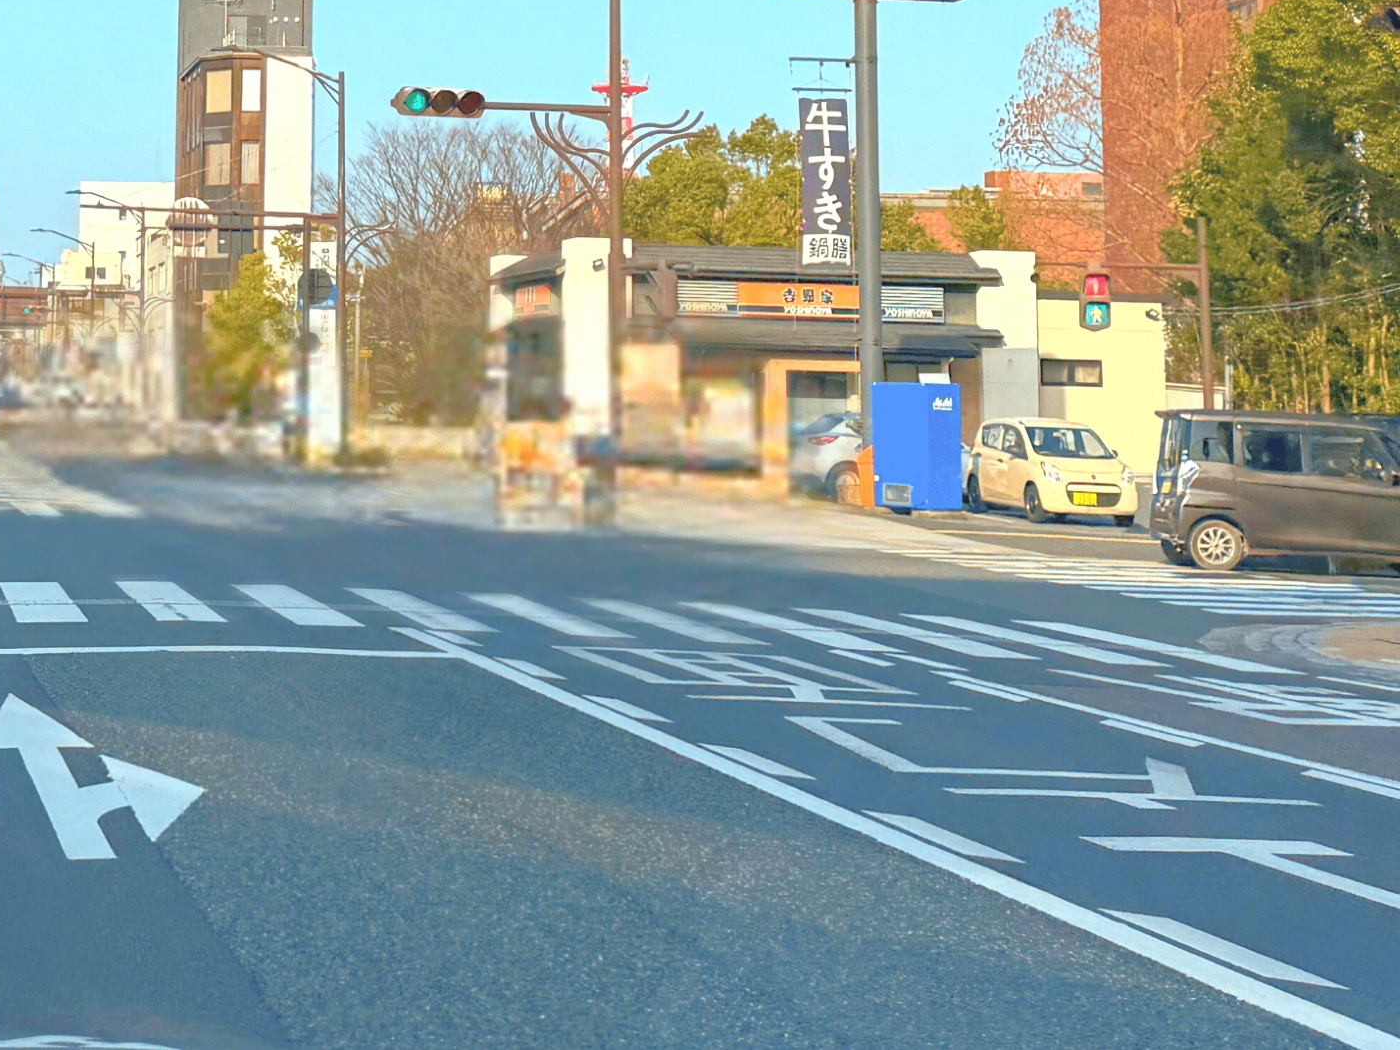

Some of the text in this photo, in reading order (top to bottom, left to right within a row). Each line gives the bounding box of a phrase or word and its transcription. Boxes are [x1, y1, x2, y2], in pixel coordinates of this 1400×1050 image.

[805, 101, 847, 232] 牛すき
[809, 237, 848, 260] 鍋膳
